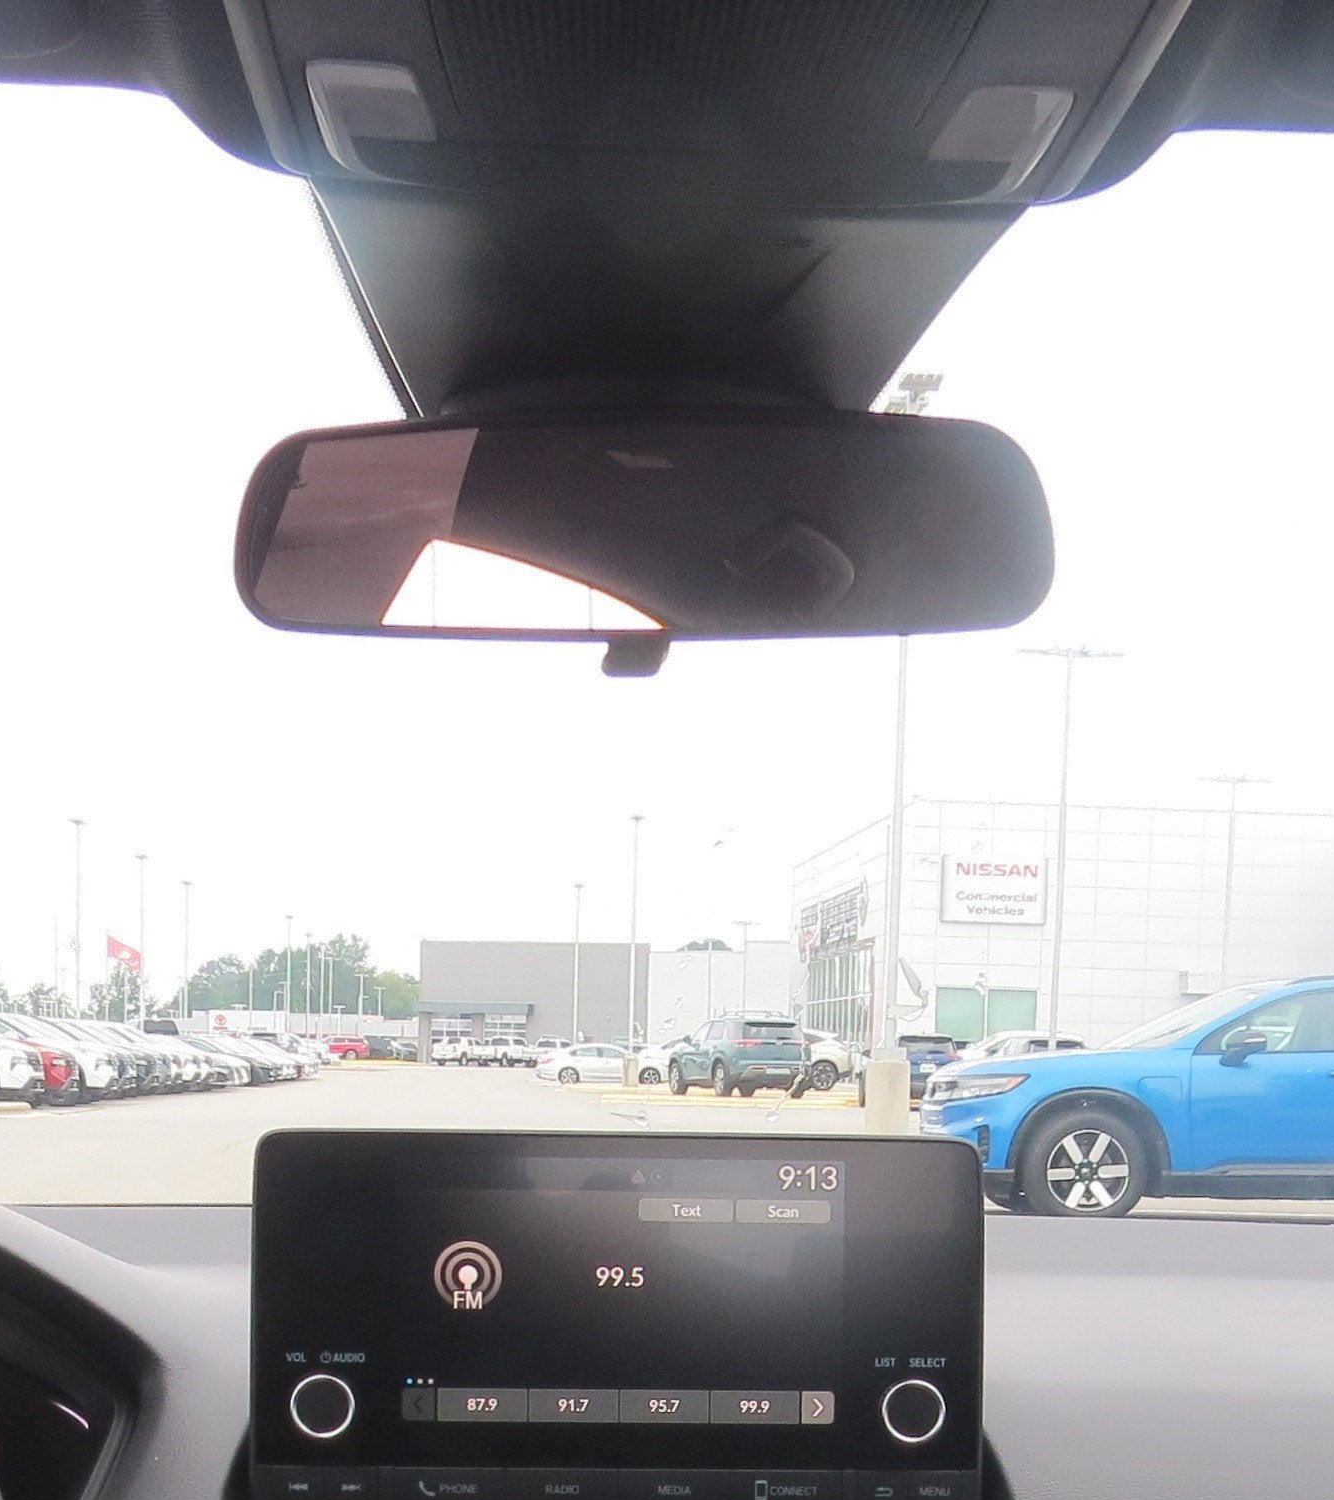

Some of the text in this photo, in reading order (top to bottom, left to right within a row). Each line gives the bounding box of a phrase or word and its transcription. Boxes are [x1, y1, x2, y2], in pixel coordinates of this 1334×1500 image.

[956, 862, 1039, 878] NISSAN
[955, 890, 1038, 903] Commercial
[966, 905, 1025, 917] Vehicles
[777, 1165, 839, 1191] 9:13
[671, 1204, 702, 1218] Text
[767, 1204, 800, 1219] Scan
[595, 1266, 645, 1288] 99.5
[453, 1291, 483, 1310] FM
[285, 1352, 366, 1363] VOL AUDIO
[874, 1357, 947, 1368] LIST SELECT
[466, 1398, 499, 1412] 87.9
[557, 1398, 590, 1413] 91.7
[648, 1399, 680, 1413] 95.7
[739, 1400, 771, 1414] 99.9
[439, 1483, 478, 1494] PHONE
[545, 1484, 581, 1495] RADIO
[657, 1485, 692, 1496] MEDIA
[769, 1485, 818, 1496] CONNECT
[919, 1486, 951, 1497] MENU
